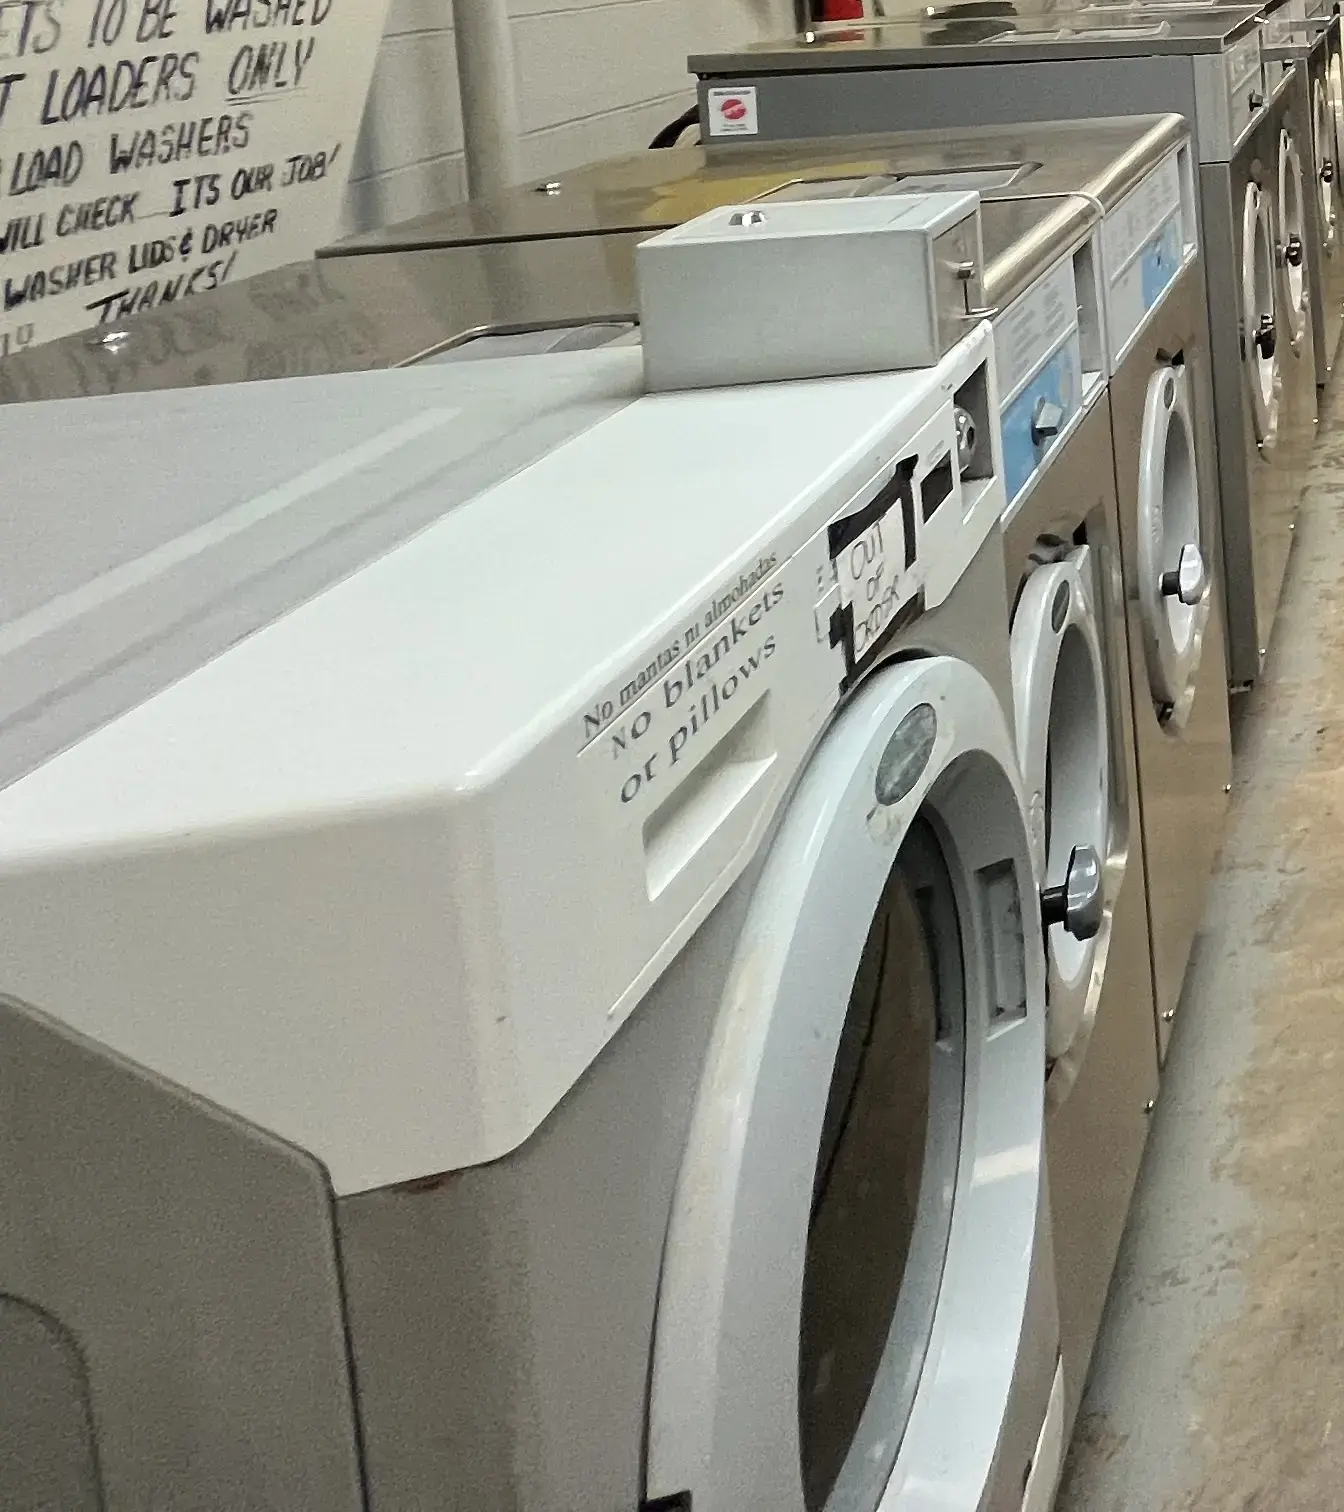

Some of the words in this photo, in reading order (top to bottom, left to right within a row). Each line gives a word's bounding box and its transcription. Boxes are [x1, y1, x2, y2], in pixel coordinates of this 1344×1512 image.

[41, 51, 200, 125] LOADERS
[228, 36, 316, 95] ONLY
[8, 139, 84, 197] LOAD
[109, 110, 254, 175] WASHERS
[56, 191, 141, 237] CHECK
[231, 163, 275, 201] OUR
[4, 251, 118, 312] WASHER
[202, 208, 278, 255] DRYER
[850, 519, 884, 581] OUT
[583, 700, 614, 738] No
[619, 639, 680, 706] mantas
[684, 621, 701, 648] ni
[704, 551, 778, 628] almohadas
[663, 581, 785, 708] blankets
[620, 752, 658, 804] or
[669, 634, 776, 766] pillows
